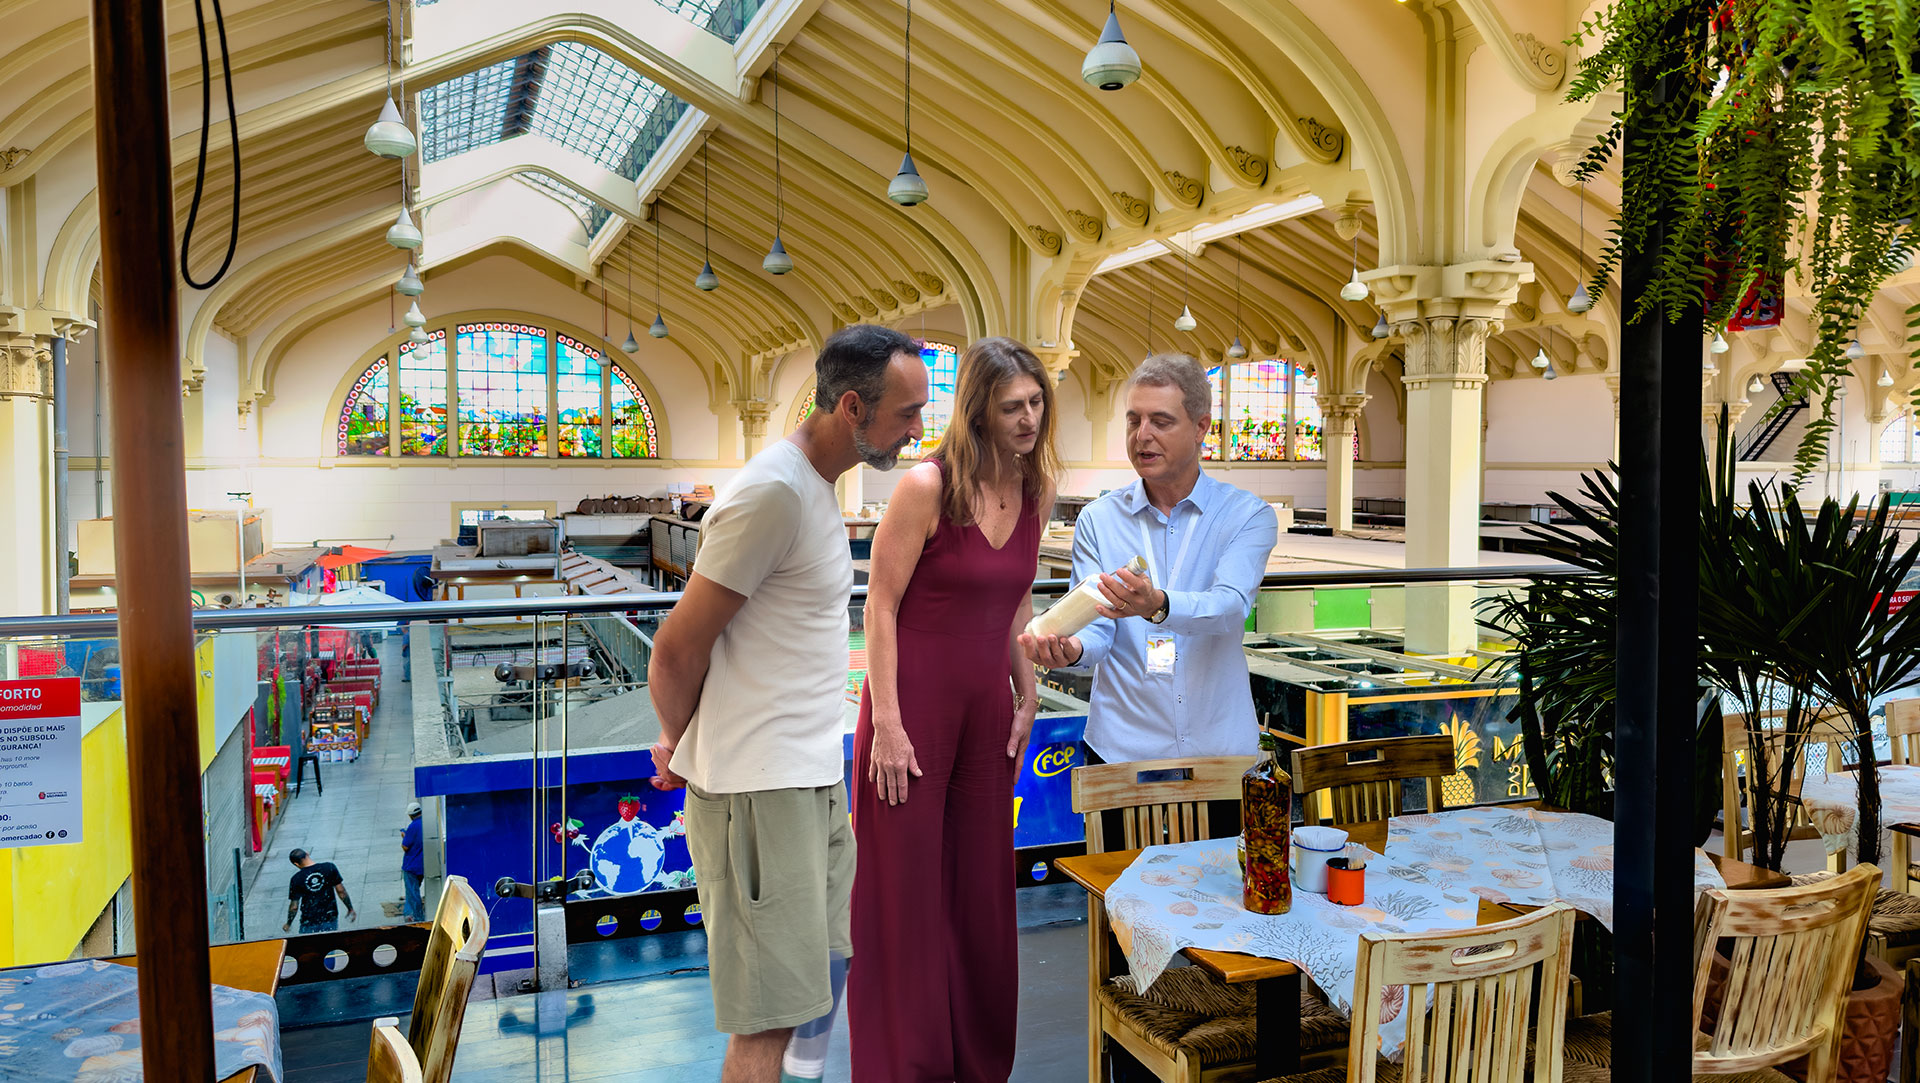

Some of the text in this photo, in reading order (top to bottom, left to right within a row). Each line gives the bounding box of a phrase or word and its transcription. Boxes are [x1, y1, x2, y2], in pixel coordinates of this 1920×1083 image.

[0, 703, 43, 712] omodidad
[1041, 746, 1076, 771] FCP
[1508, 764, 1521, 796] DAS
[0, 834, 43, 842] omercadao
